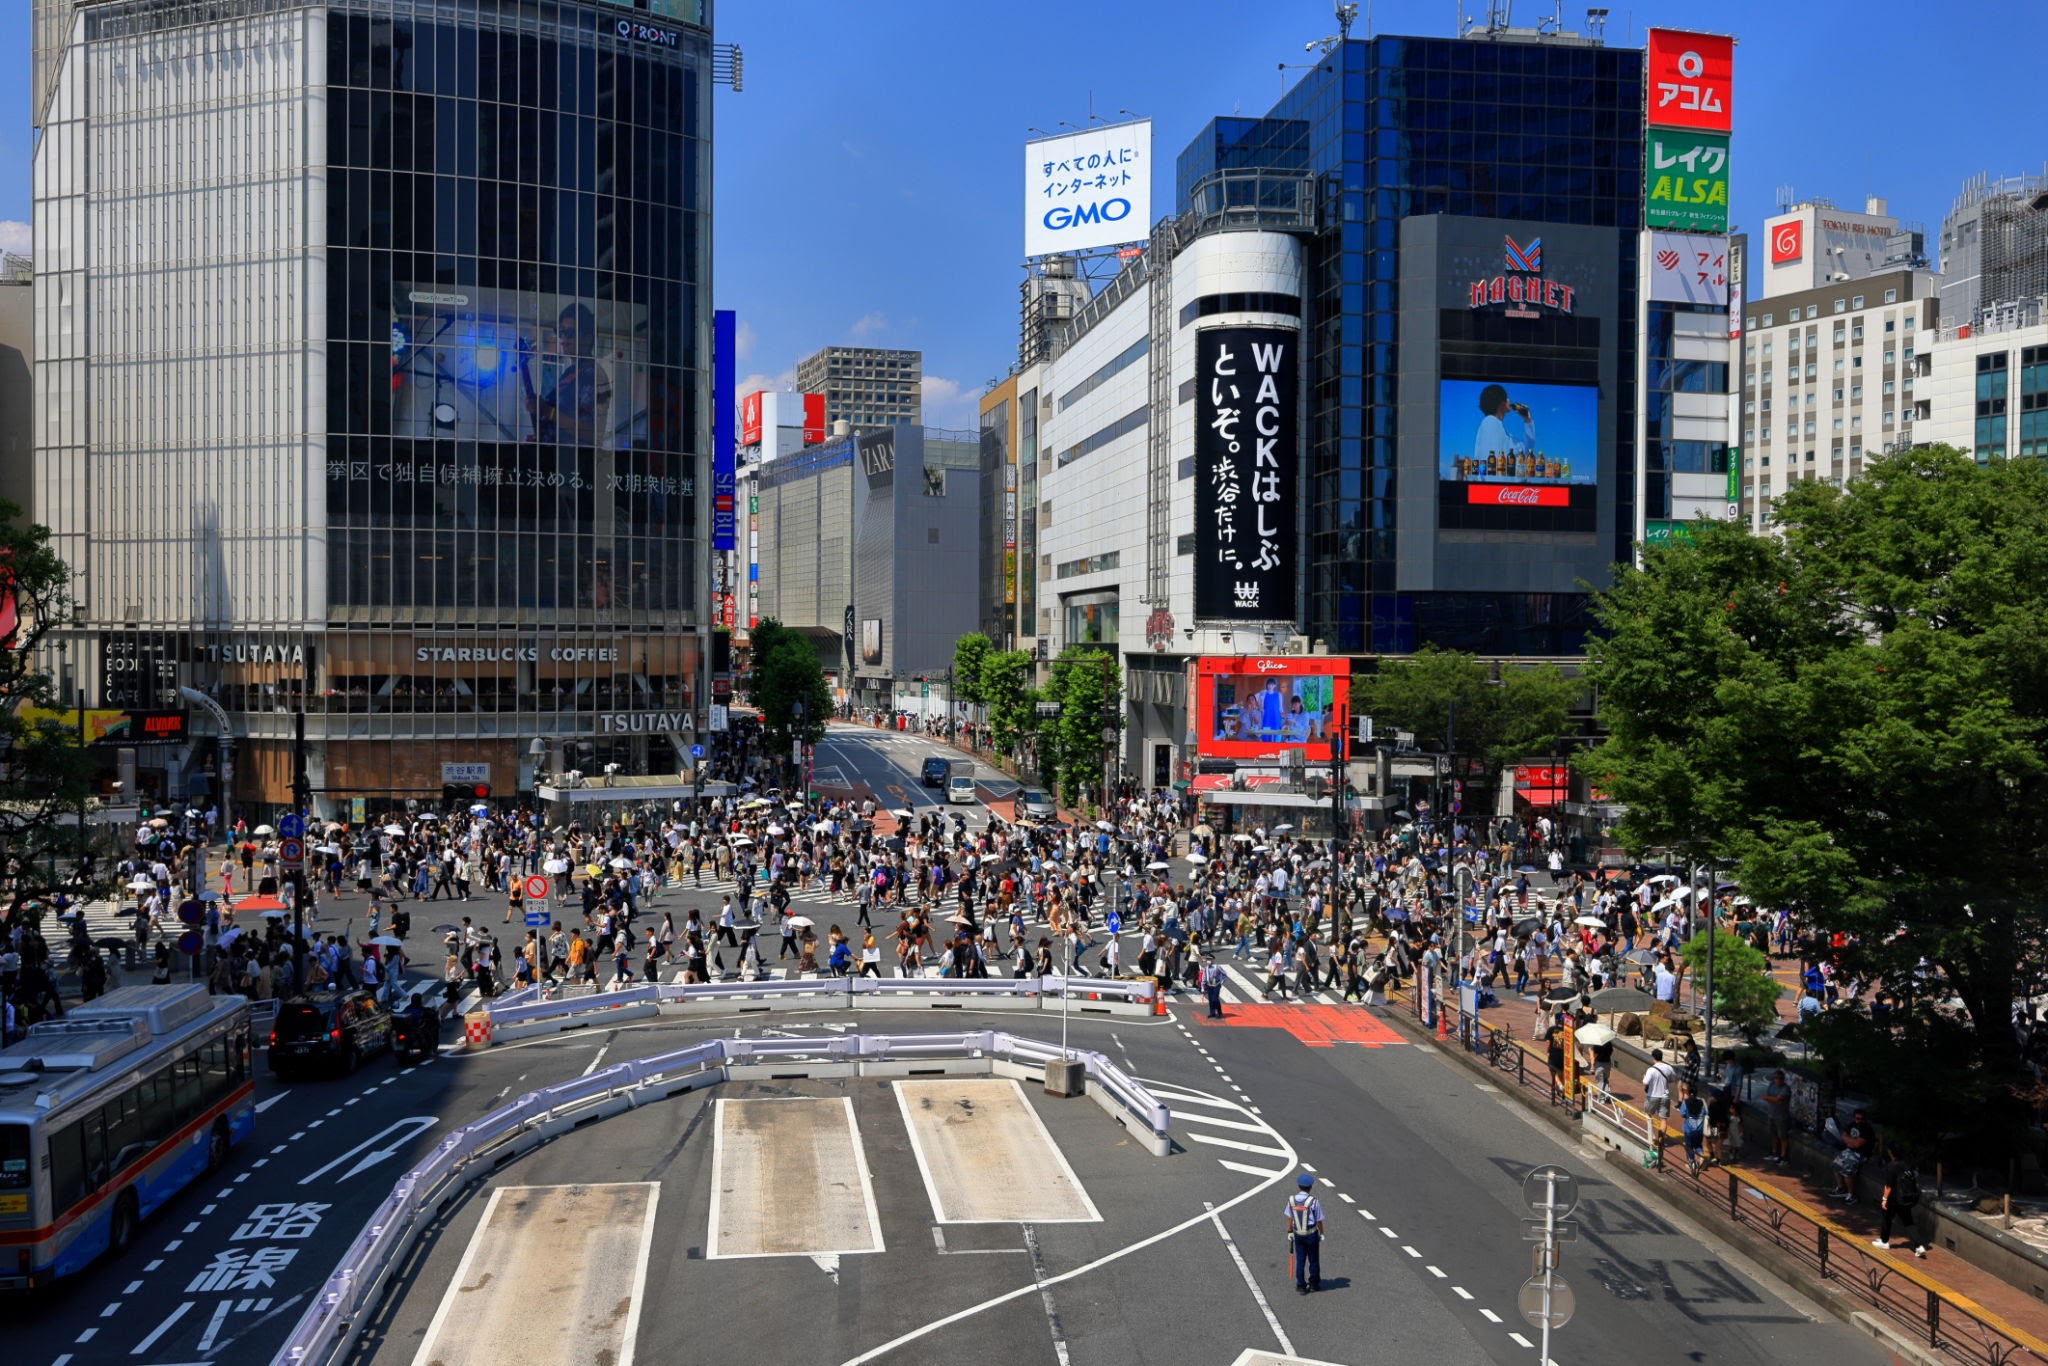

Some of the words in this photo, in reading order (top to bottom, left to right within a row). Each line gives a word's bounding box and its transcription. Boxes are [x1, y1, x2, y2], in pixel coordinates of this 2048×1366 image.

[1657, 82, 1723, 113] アコム
[1043, 148, 1132, 178] すべての人に
[1654, 142, 1726, 174] レイク
[1043, 169, 1132, 198] インターネット
[1650, 175, 1727, 206] ALSA
[1043, 197, 1132, 230] GMO
[1823, 219, 1850, 232] TOKYU
[1852, 223, 1866, 234] REI
[1697, 252, 1724, 268] アイ
[1697, 272, 1725, 286] フル
[1469, 276, 1575, 314] MAGNET
[716, 473, 733, 537] SEIBU
[1646, 529, 1669, 538] レイク
[1234, 600, 1260, 608] WACK
[208, 644, 303, 663] TSUTAYA
[417, 647, 537, 662] STARBUCKS
[551, 647, 618, 662] COFFEE
[1257, 660, 1288, 672] Glico
[866, 678, 880, 690] ZARA
[600, 713, 694, 733] TSUTAYA
[445, 765, 486, 775] 渋谷駅前
